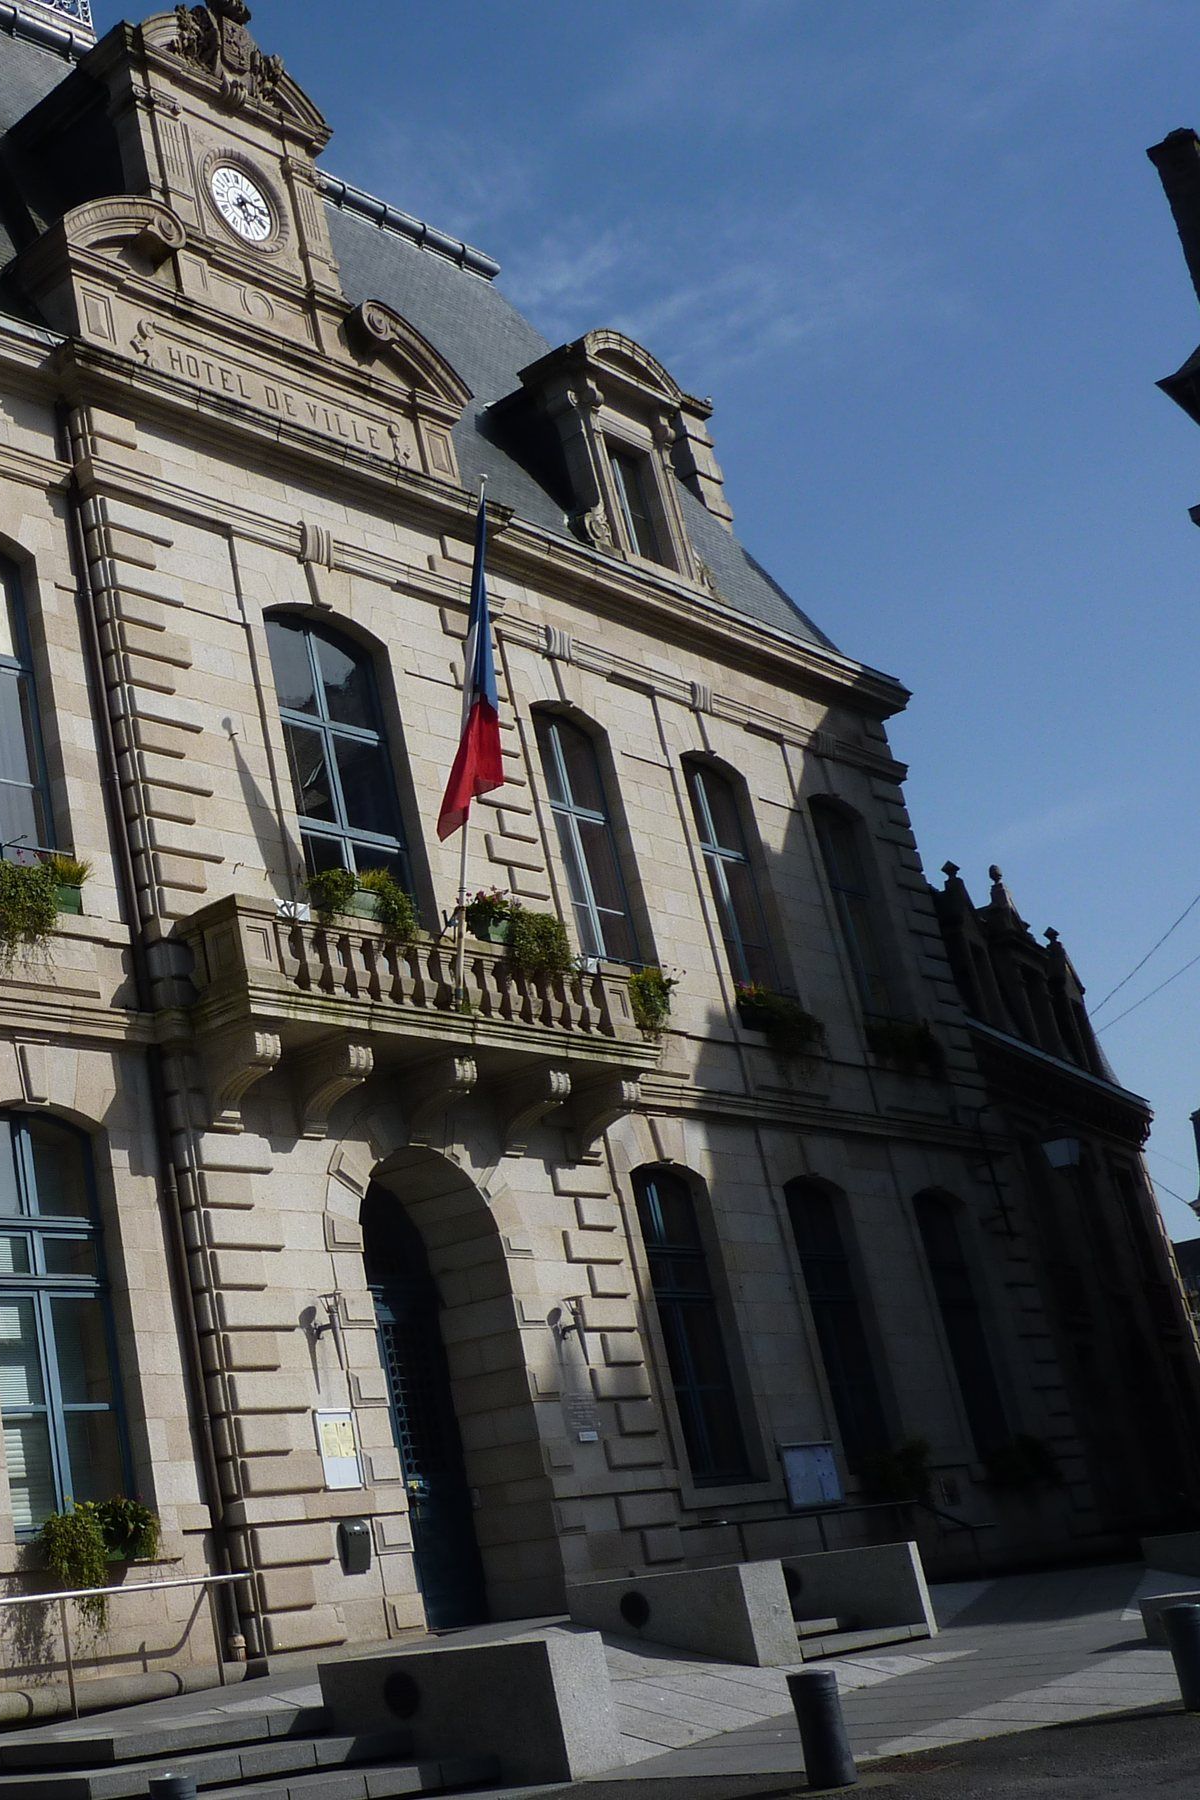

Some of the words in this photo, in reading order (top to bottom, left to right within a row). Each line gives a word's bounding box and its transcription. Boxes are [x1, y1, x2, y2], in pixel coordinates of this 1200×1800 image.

[167, 346, 252, 400] HOTEL
[264, 385, 297, 417] DE
[305, 401, 381, 450] VILLE
